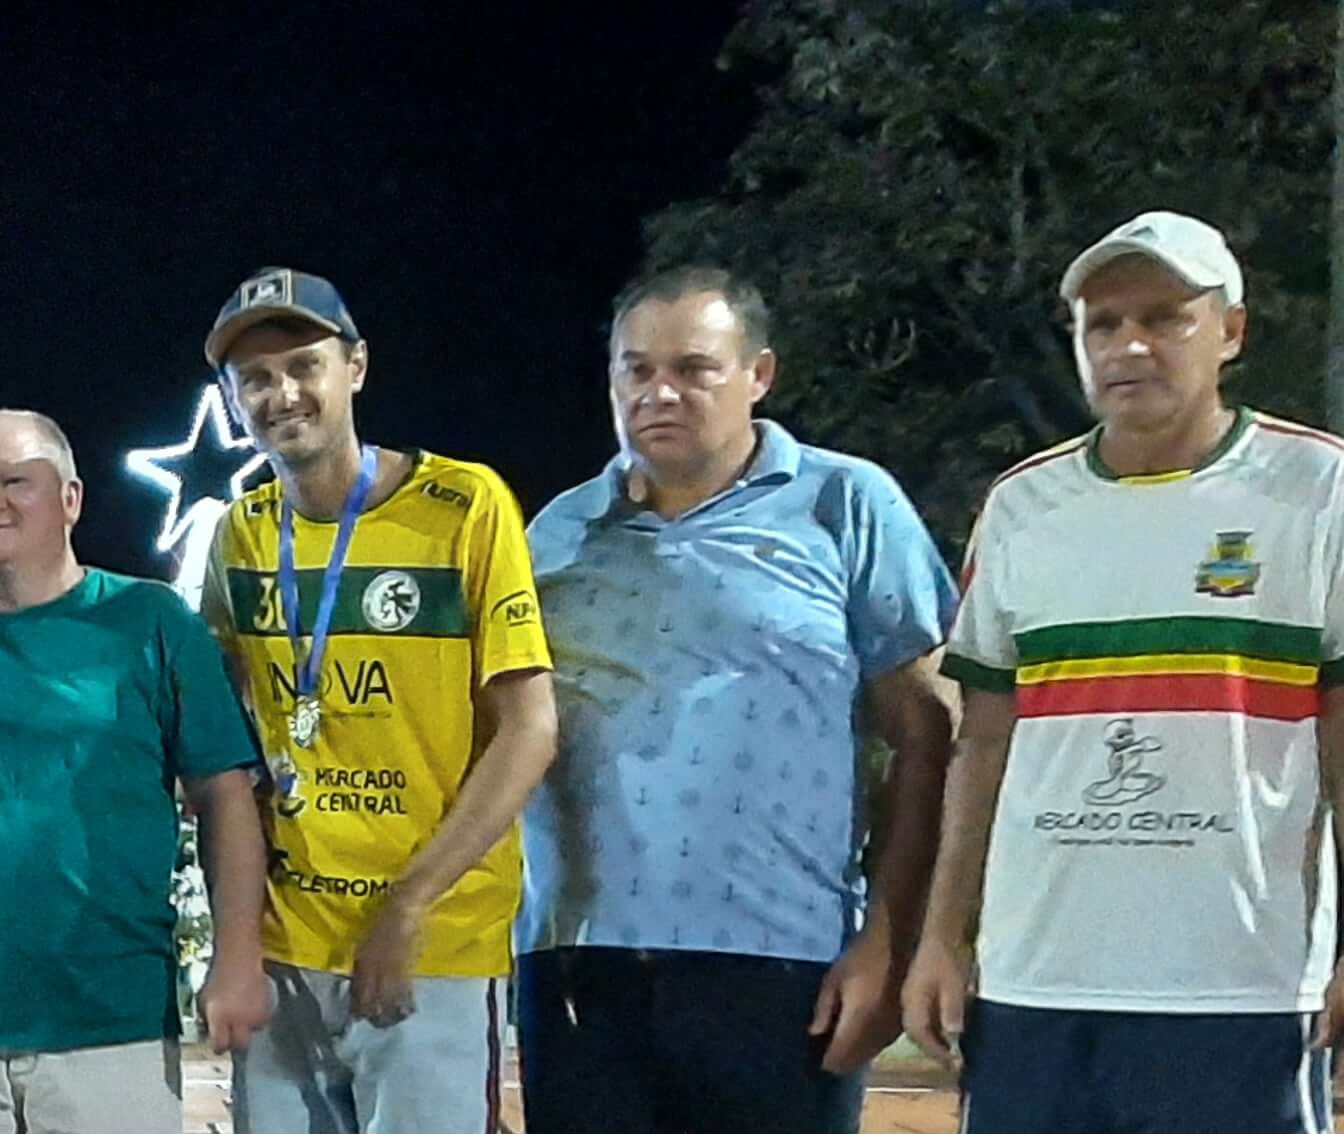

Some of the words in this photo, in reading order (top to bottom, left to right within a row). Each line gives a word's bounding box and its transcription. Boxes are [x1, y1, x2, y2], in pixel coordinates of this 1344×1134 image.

[315, 768, 407, 789] MERCADO
[315, 793, 407, 815] CENTRAL
[1128, 811, 1234, 833] CENTRAL
[287, 870, 394, 897] LETROM
